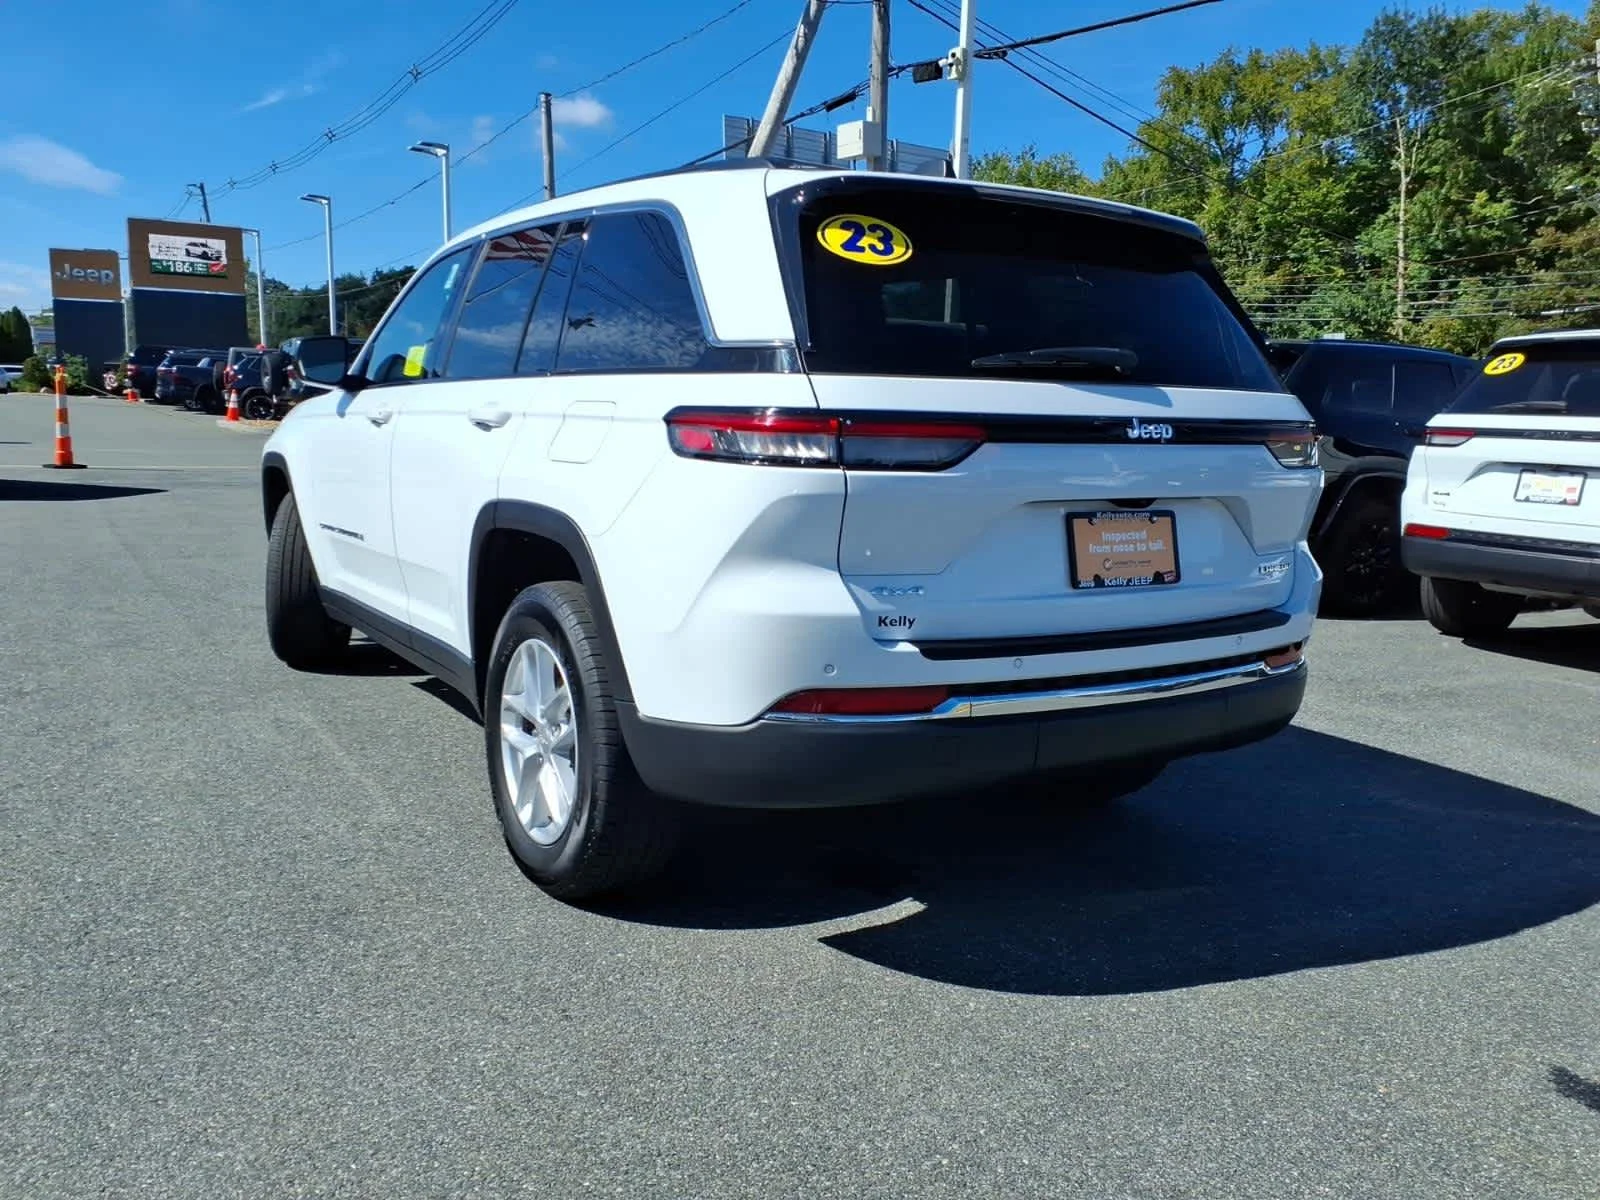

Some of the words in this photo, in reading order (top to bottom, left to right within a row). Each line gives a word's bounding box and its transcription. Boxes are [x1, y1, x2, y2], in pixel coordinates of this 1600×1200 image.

[839, 220, 894, 256] 23
[55, 263, 114, 286] Jeep
[1490, 356, 1517, 371] 23
[1125, 417, 1173, 444] Jeep
[1102, 529, 1147, 542] Inspected
[1089, 543, 1111, 553] from
[1113, 543, 1134, 552] nose
[1137, 542, 1146, 551] to
[1104, 576, 1127, 586] Kelly
[1129, 576, 1153, 585] JEEP
[878, 615, 916, 629] Kelly
